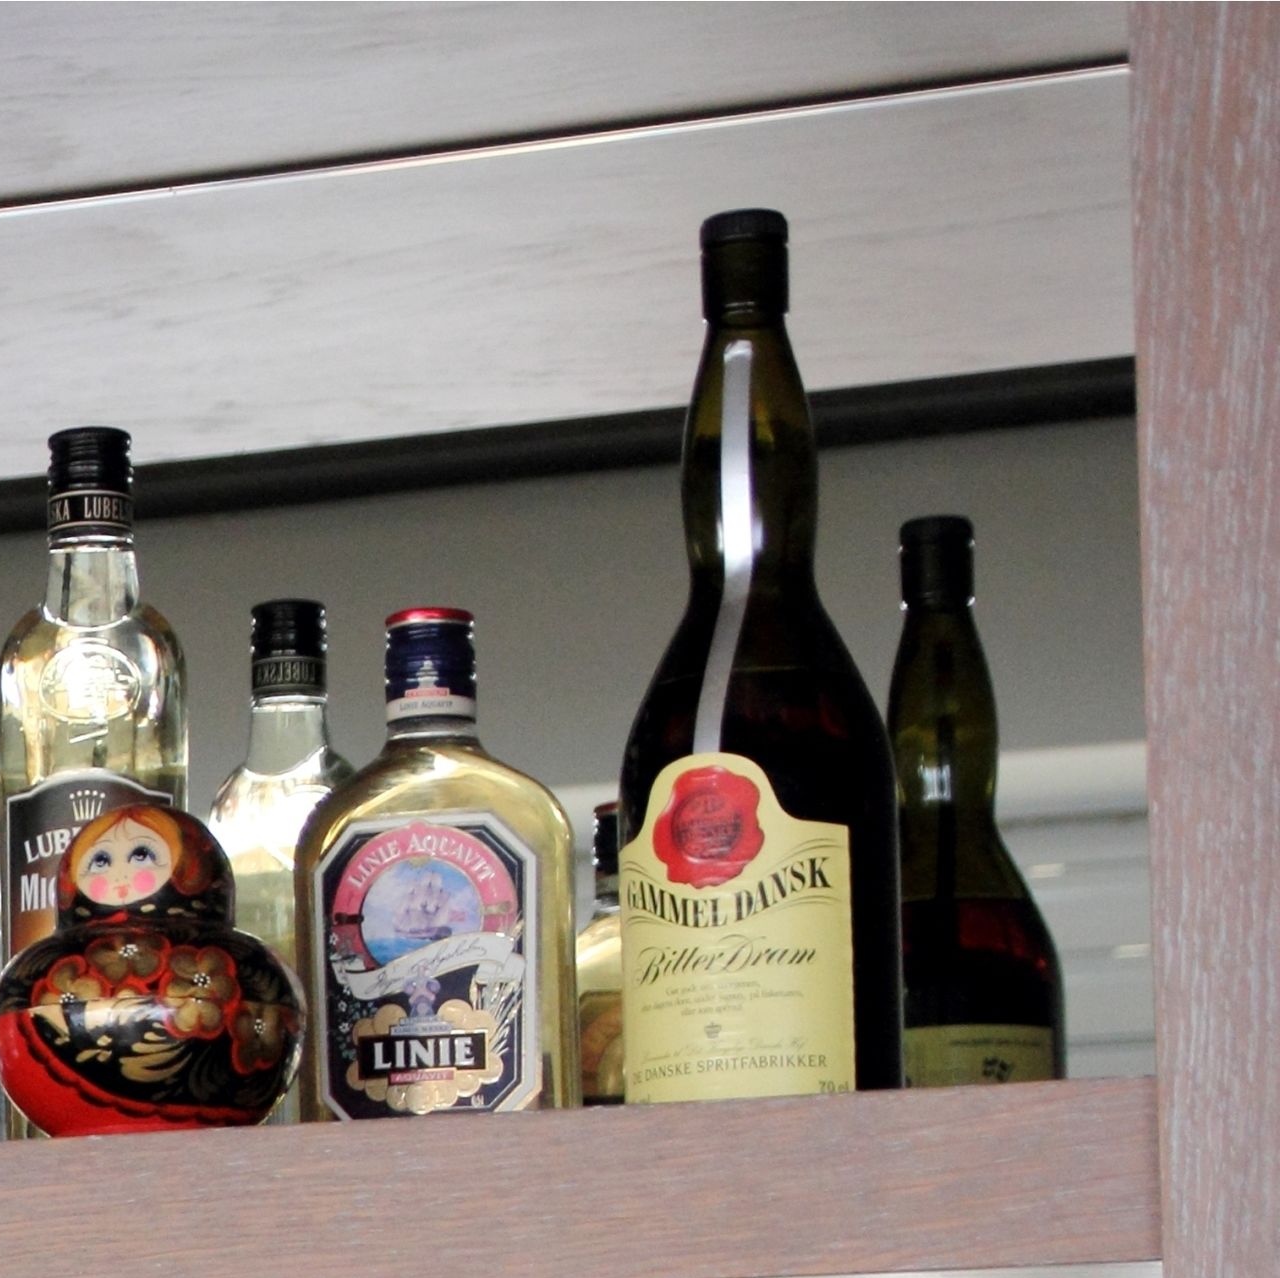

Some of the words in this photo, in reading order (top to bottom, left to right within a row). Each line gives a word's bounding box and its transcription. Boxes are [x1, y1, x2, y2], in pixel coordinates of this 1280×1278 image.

[348, 840, 401, 890] LINIE
[406, 832, 497, 882] AQUAVIT
[627, 879, 728, 928] GAMMEL
[734, 856, 833, 921] DANSK
[636, 945, 724, 985] Bitter
[717, 933, 817, 974] Dram
[373, 1036, 475, 1070] LINIE
[645, 1060, 692, 1080] DANSKE
[697, 1054, 828, 1074] SPRITFABRIKKER
